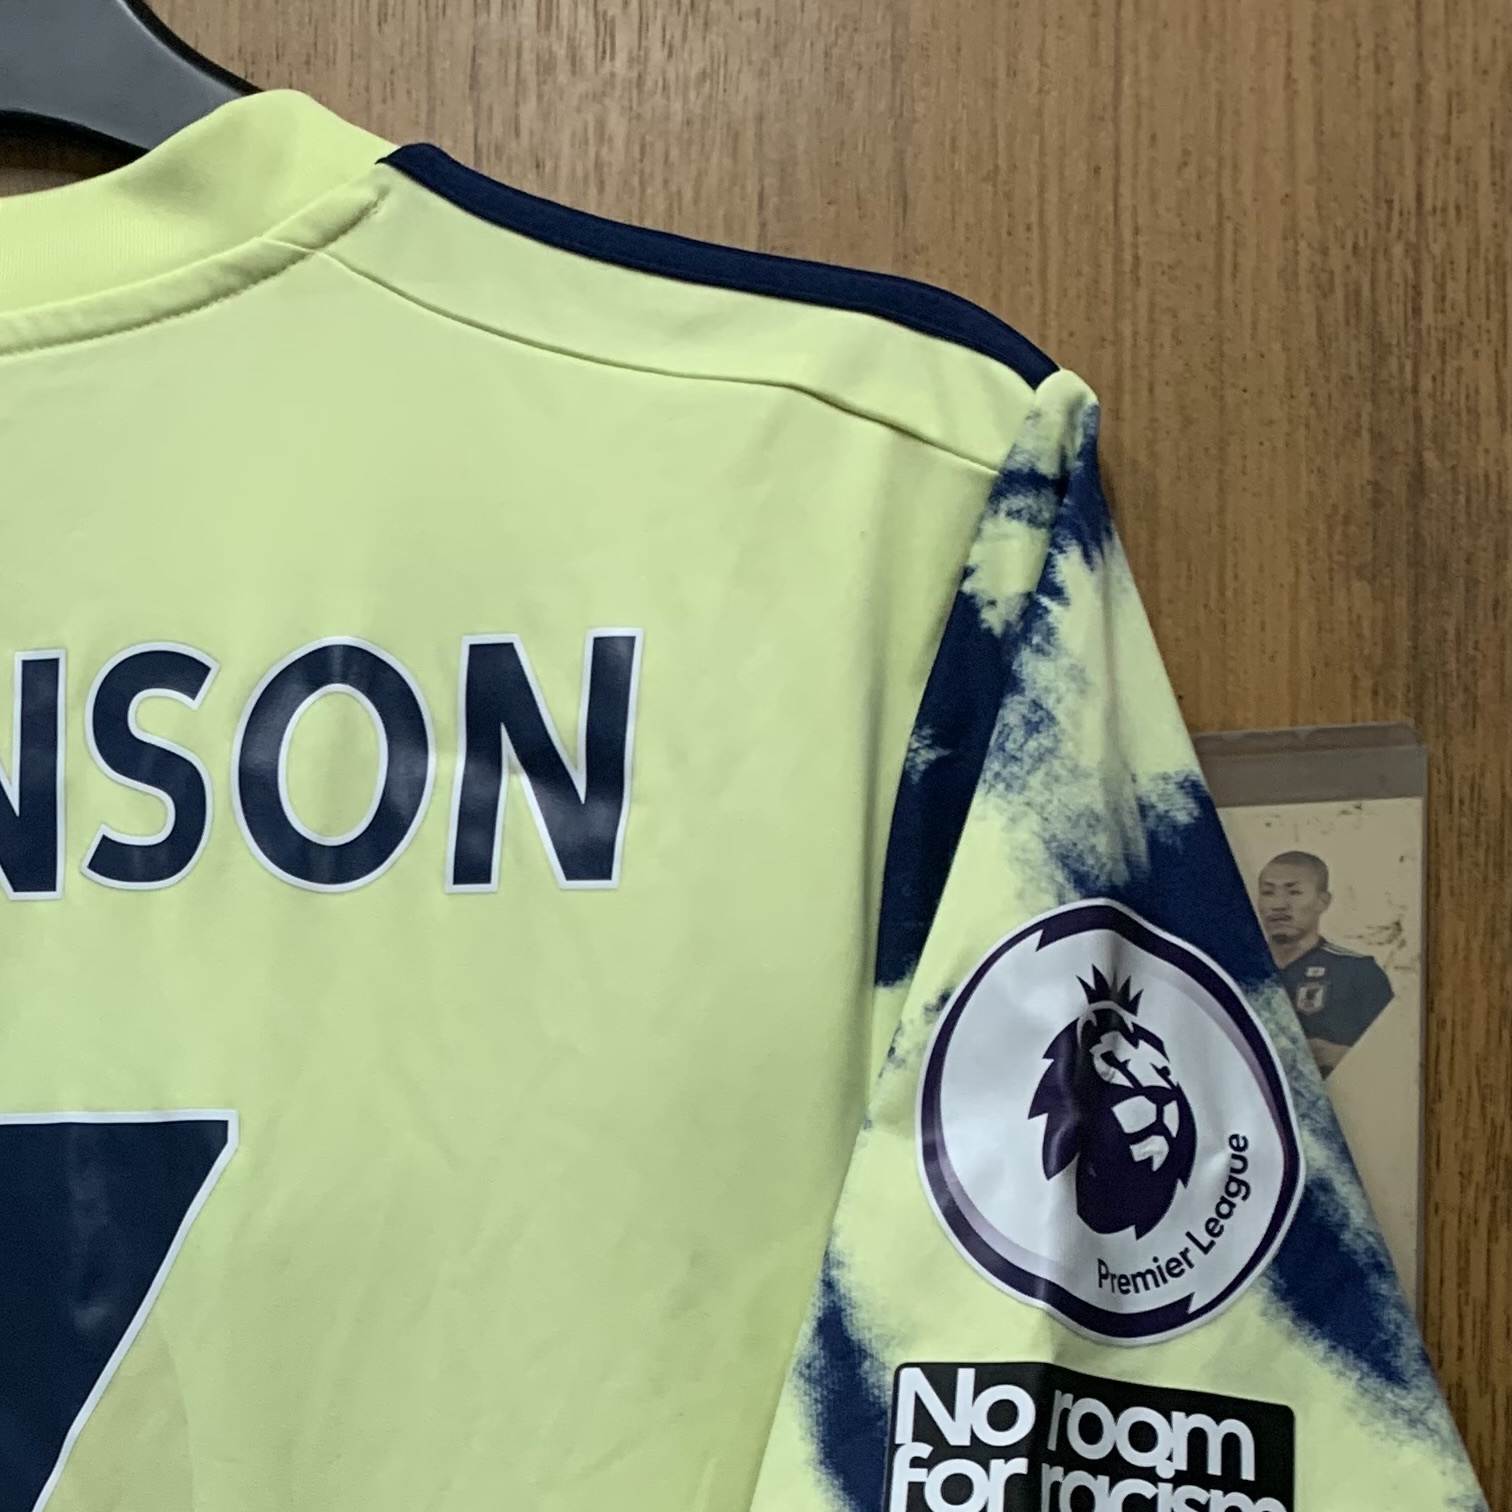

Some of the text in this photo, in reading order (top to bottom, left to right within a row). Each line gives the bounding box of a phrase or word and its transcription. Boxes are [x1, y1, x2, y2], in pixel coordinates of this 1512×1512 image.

[1097, 1131, 1251, 1296] Premier League
[894, 1366, 1256, 1482] No room
